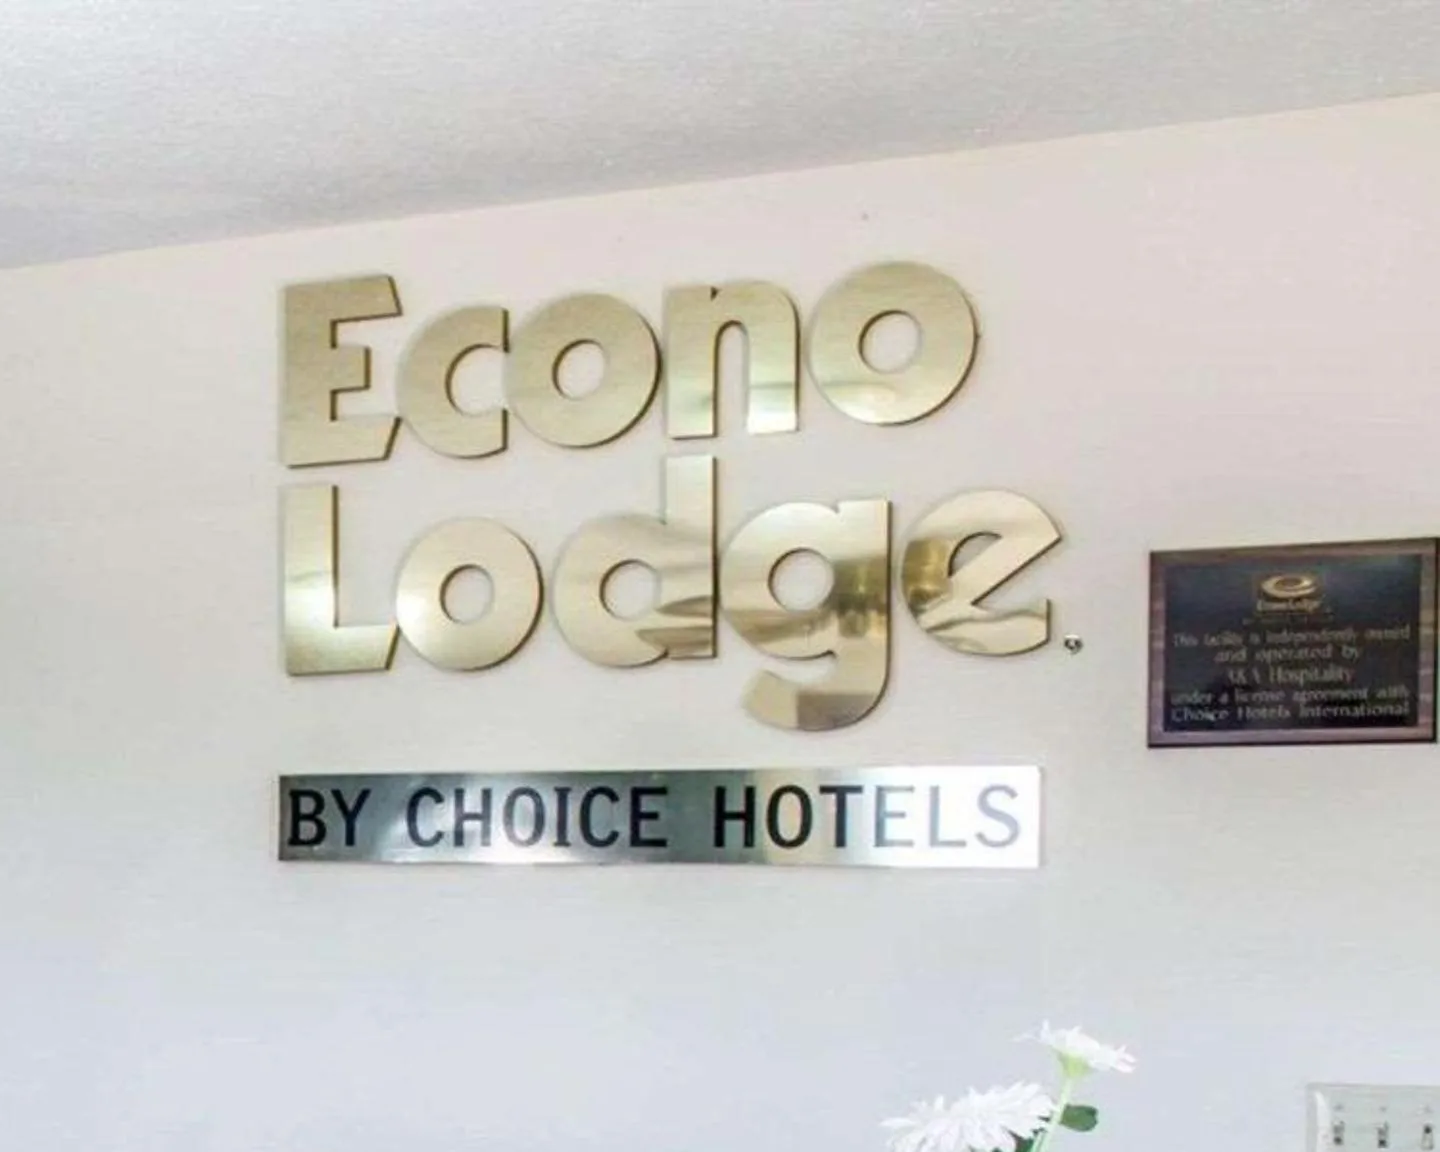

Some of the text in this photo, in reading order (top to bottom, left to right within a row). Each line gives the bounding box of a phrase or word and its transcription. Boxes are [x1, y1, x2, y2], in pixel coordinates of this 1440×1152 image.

[285, 260, 980, 468] Econo
[284, 453, 1063, 732] Lodge
[1171, 700, 1411, 722] Choice Hotels International
[286, 783, 1022, 850] BY CHOICE HOTELS
